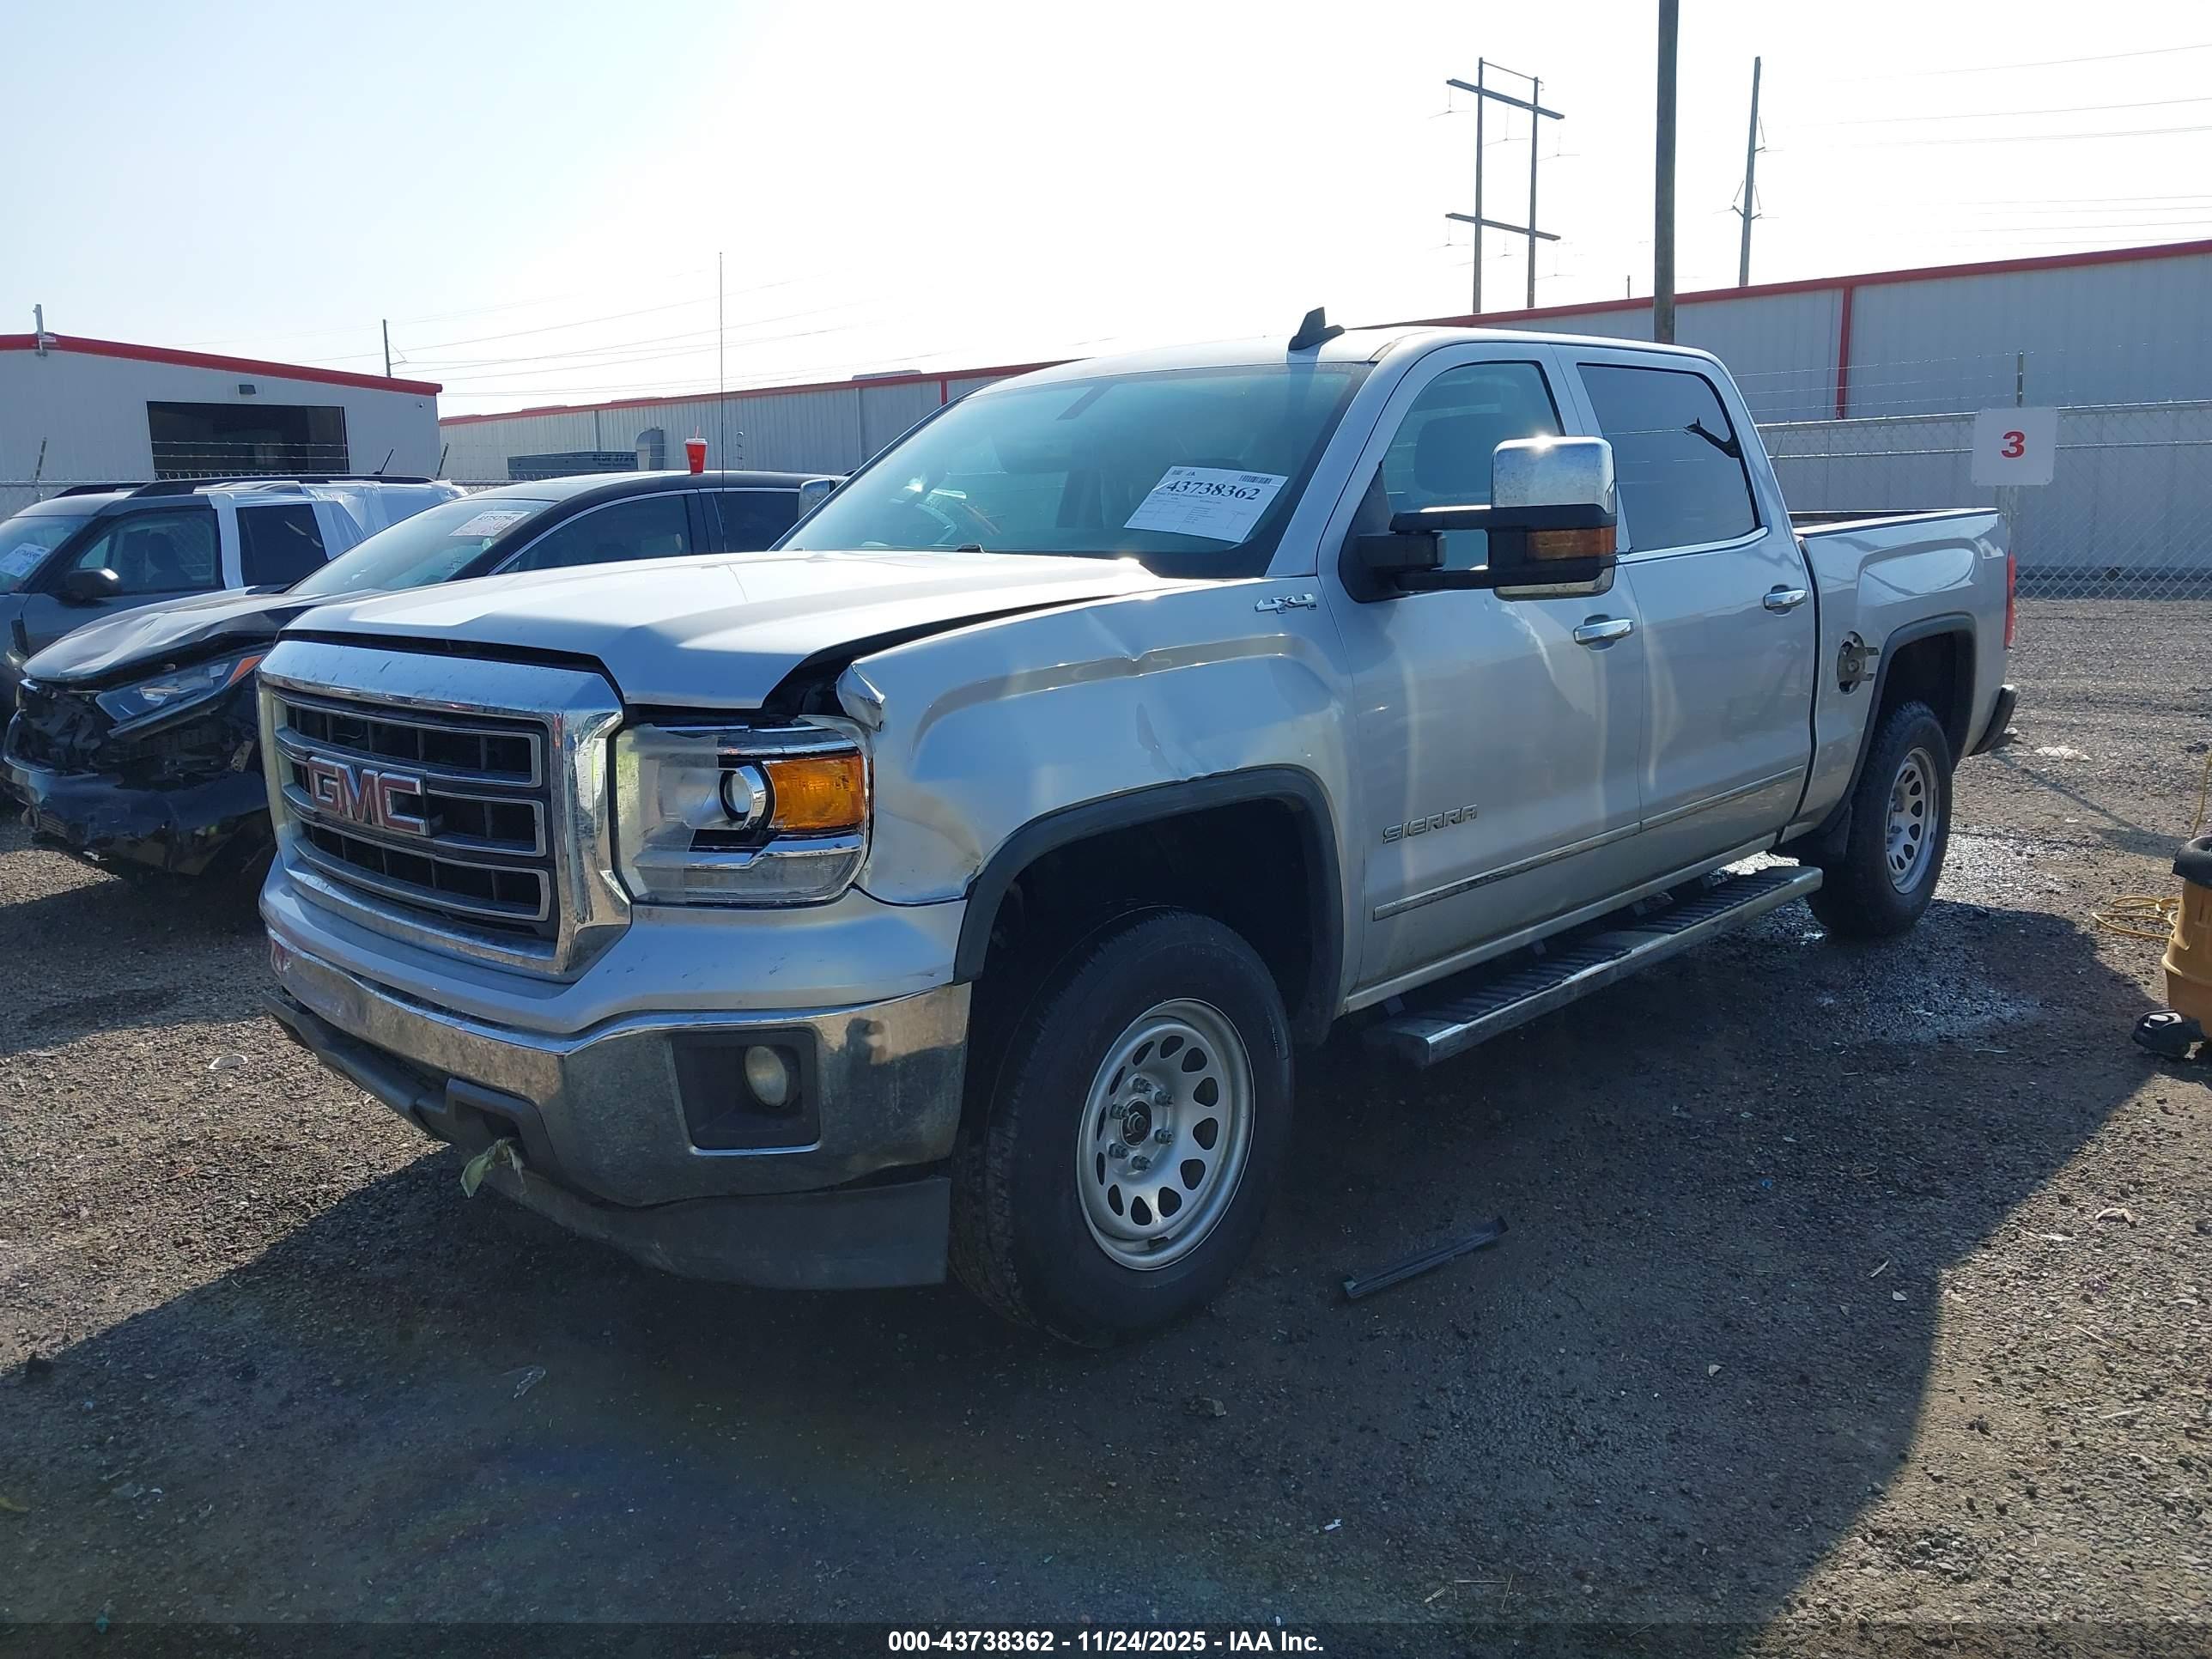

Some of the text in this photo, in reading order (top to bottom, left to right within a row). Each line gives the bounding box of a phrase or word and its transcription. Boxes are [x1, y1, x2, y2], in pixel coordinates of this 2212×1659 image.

[2001, 431, 2026, 459] 3
[1166, 480, 1261, 501] 43738362
[307, 756, 427, 836] GMC
[1382, 803, 1478, 845] SIERRA
